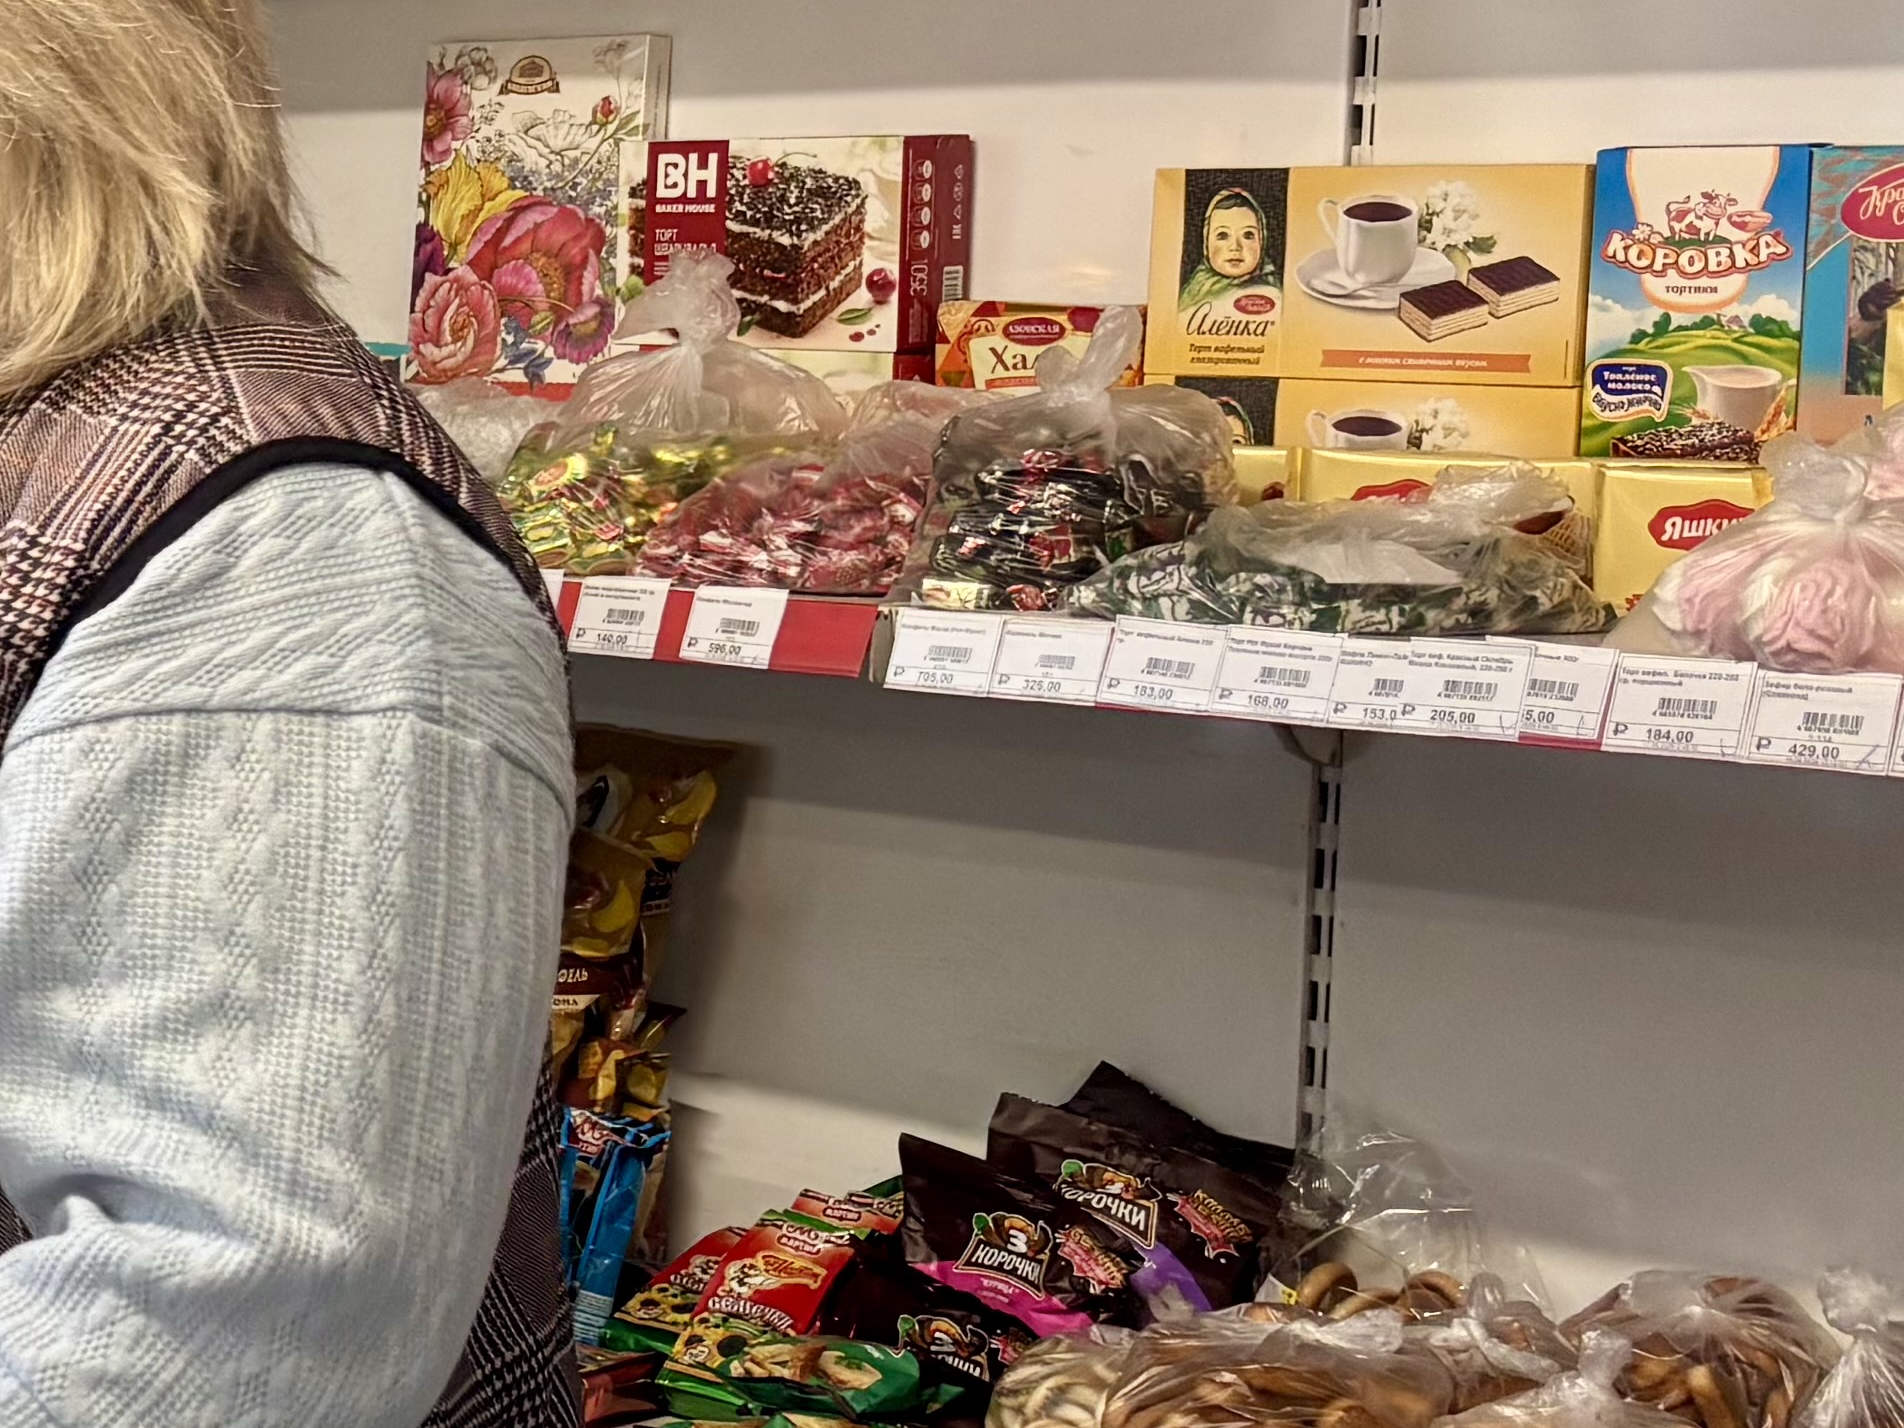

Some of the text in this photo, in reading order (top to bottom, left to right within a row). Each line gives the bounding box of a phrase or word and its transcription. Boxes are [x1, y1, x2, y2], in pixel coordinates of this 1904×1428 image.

[655, 203, 716, 213] BAKER HOUSE
[654, 228, 678, 243] ТОРТ
[1600, 228, 1794, 280] КОРОВКА
[1185, 300, 1272, 338] Алёнка
[988, 345, 1040, 374] Хал
[1247, 693, 1290, 710] 168,00
[1362, 707, 1398, 722] 153,0
[1429, 708, 1477, 725] 205,00
[1645, 727, 1695, 743] 184,00
[1786, 742, 1841, 760] 429,00
